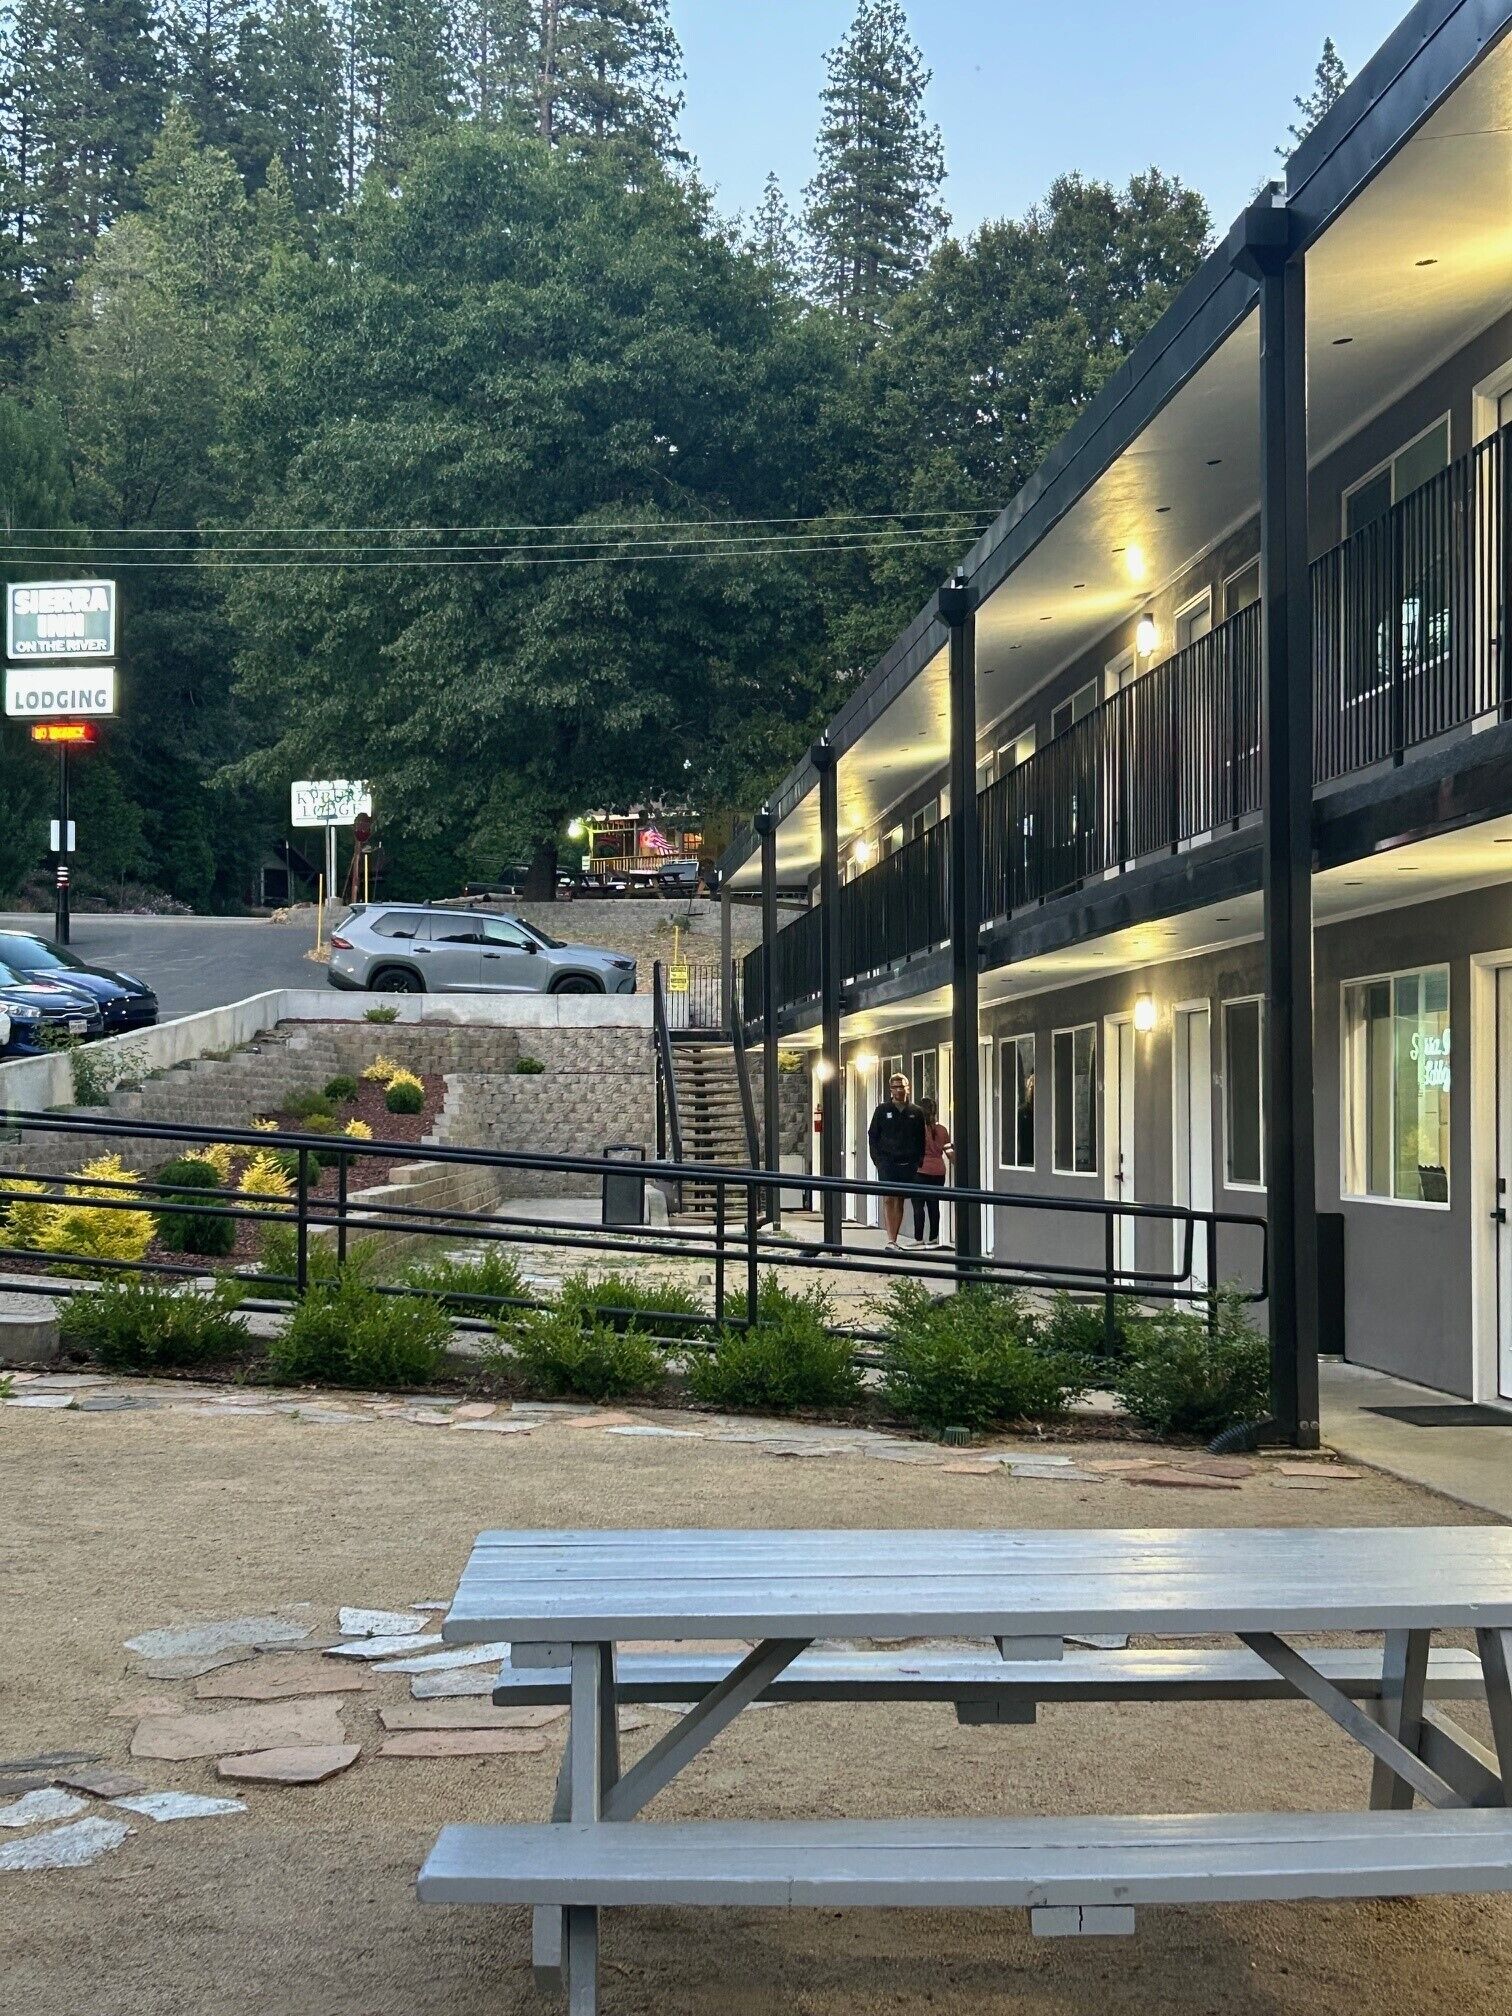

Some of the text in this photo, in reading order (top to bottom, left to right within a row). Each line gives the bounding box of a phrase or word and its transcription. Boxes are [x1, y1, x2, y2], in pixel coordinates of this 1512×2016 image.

[14, 588, 109, 614] SIERRA
[37, 613, 85, 638] INN
[16, 638, 107, 652] ON THE RIVER
[15, 690, 107, 709] LODGING
